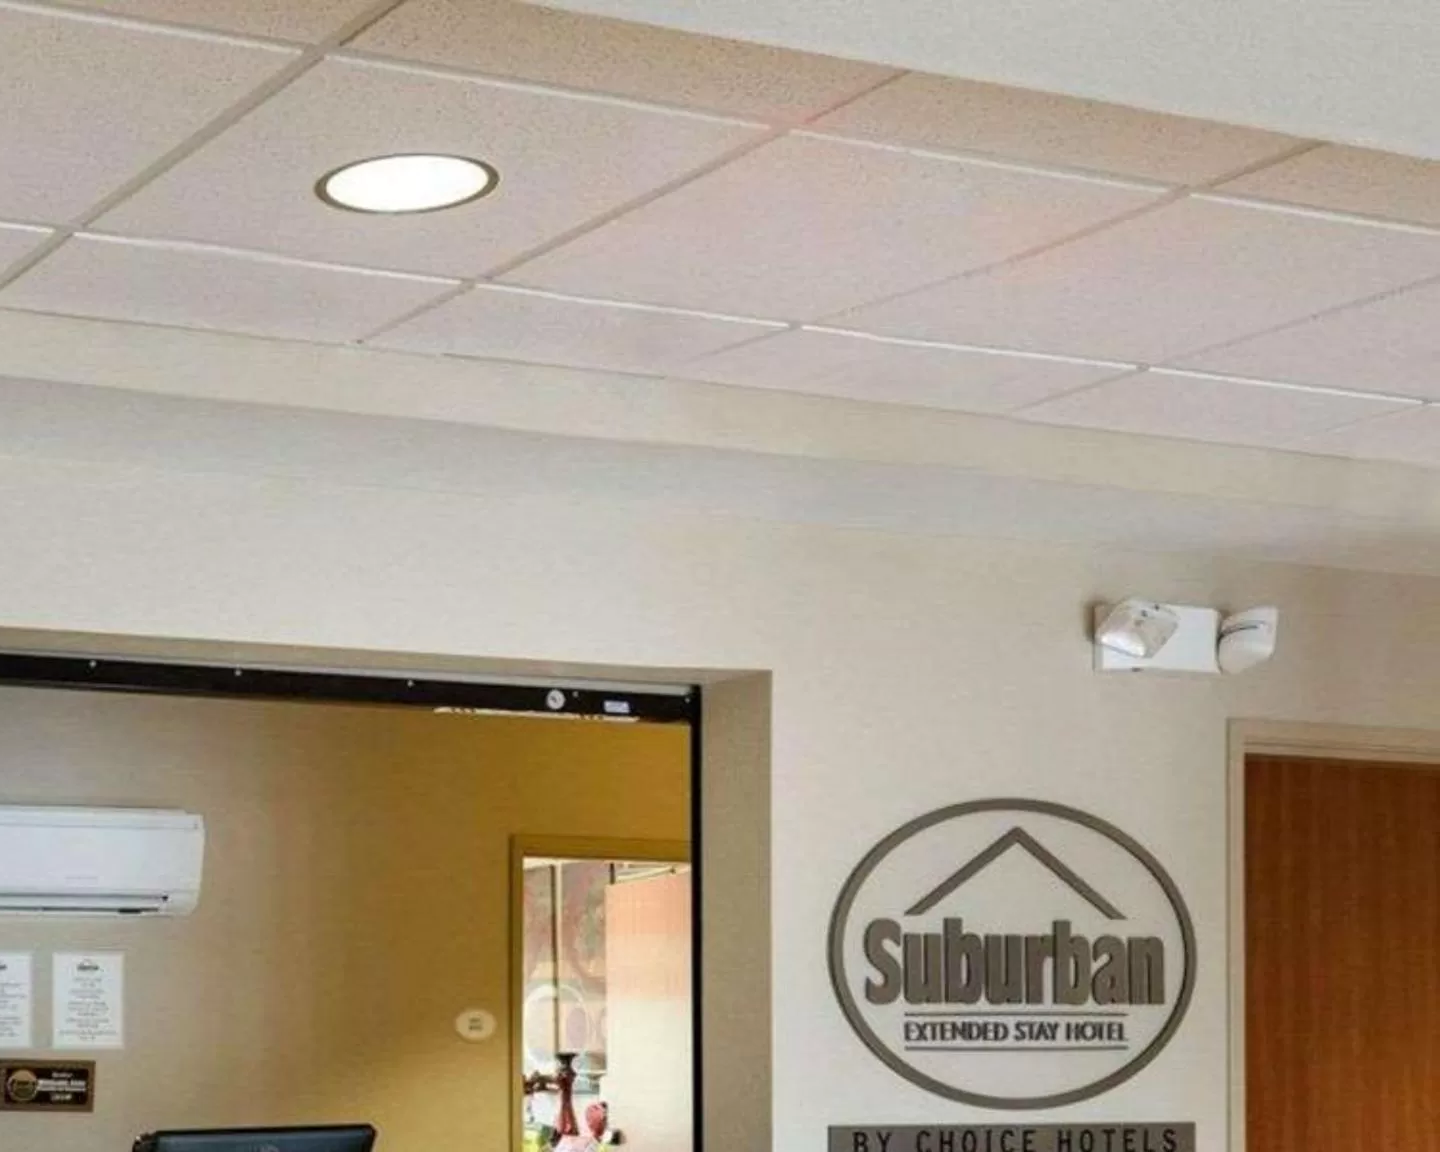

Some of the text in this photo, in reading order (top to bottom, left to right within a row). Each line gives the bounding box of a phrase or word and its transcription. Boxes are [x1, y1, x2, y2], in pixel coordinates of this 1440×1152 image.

[863, 917, 1165, 1006] Suburban
[904, 1021, 1128, 1042] EXTENDED STAY HOTEL
